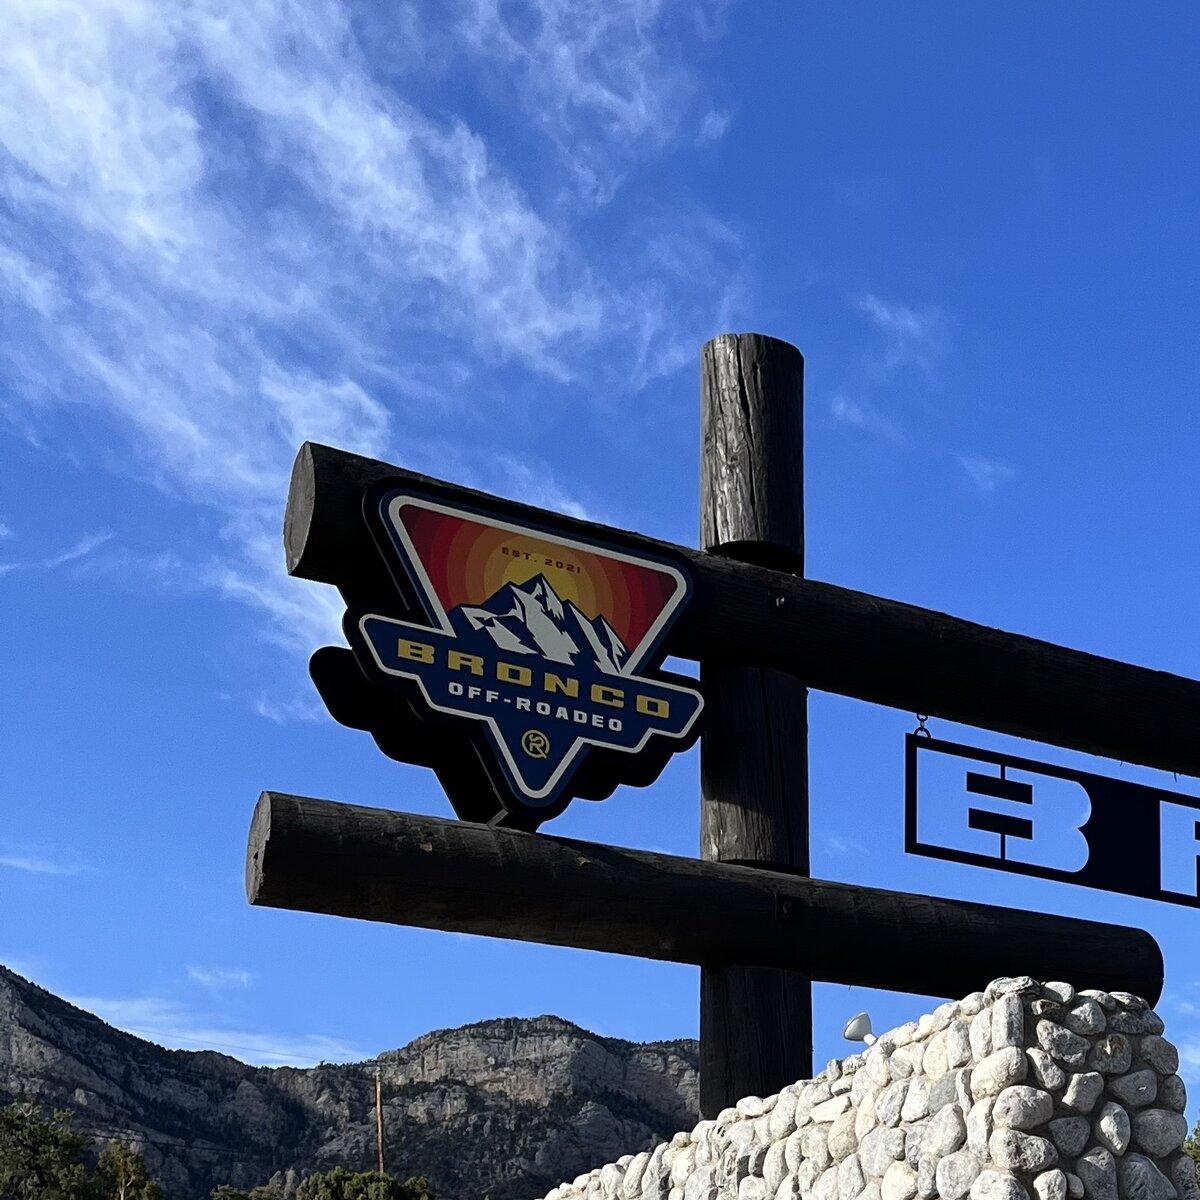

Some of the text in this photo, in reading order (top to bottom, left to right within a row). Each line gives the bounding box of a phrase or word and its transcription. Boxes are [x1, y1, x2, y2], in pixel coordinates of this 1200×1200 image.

[502, 546, 581, 575] EST. 2021
[397, 638, 670, 719] BRONCO
[448, 682, 623, 732] OFF-ROADEO
